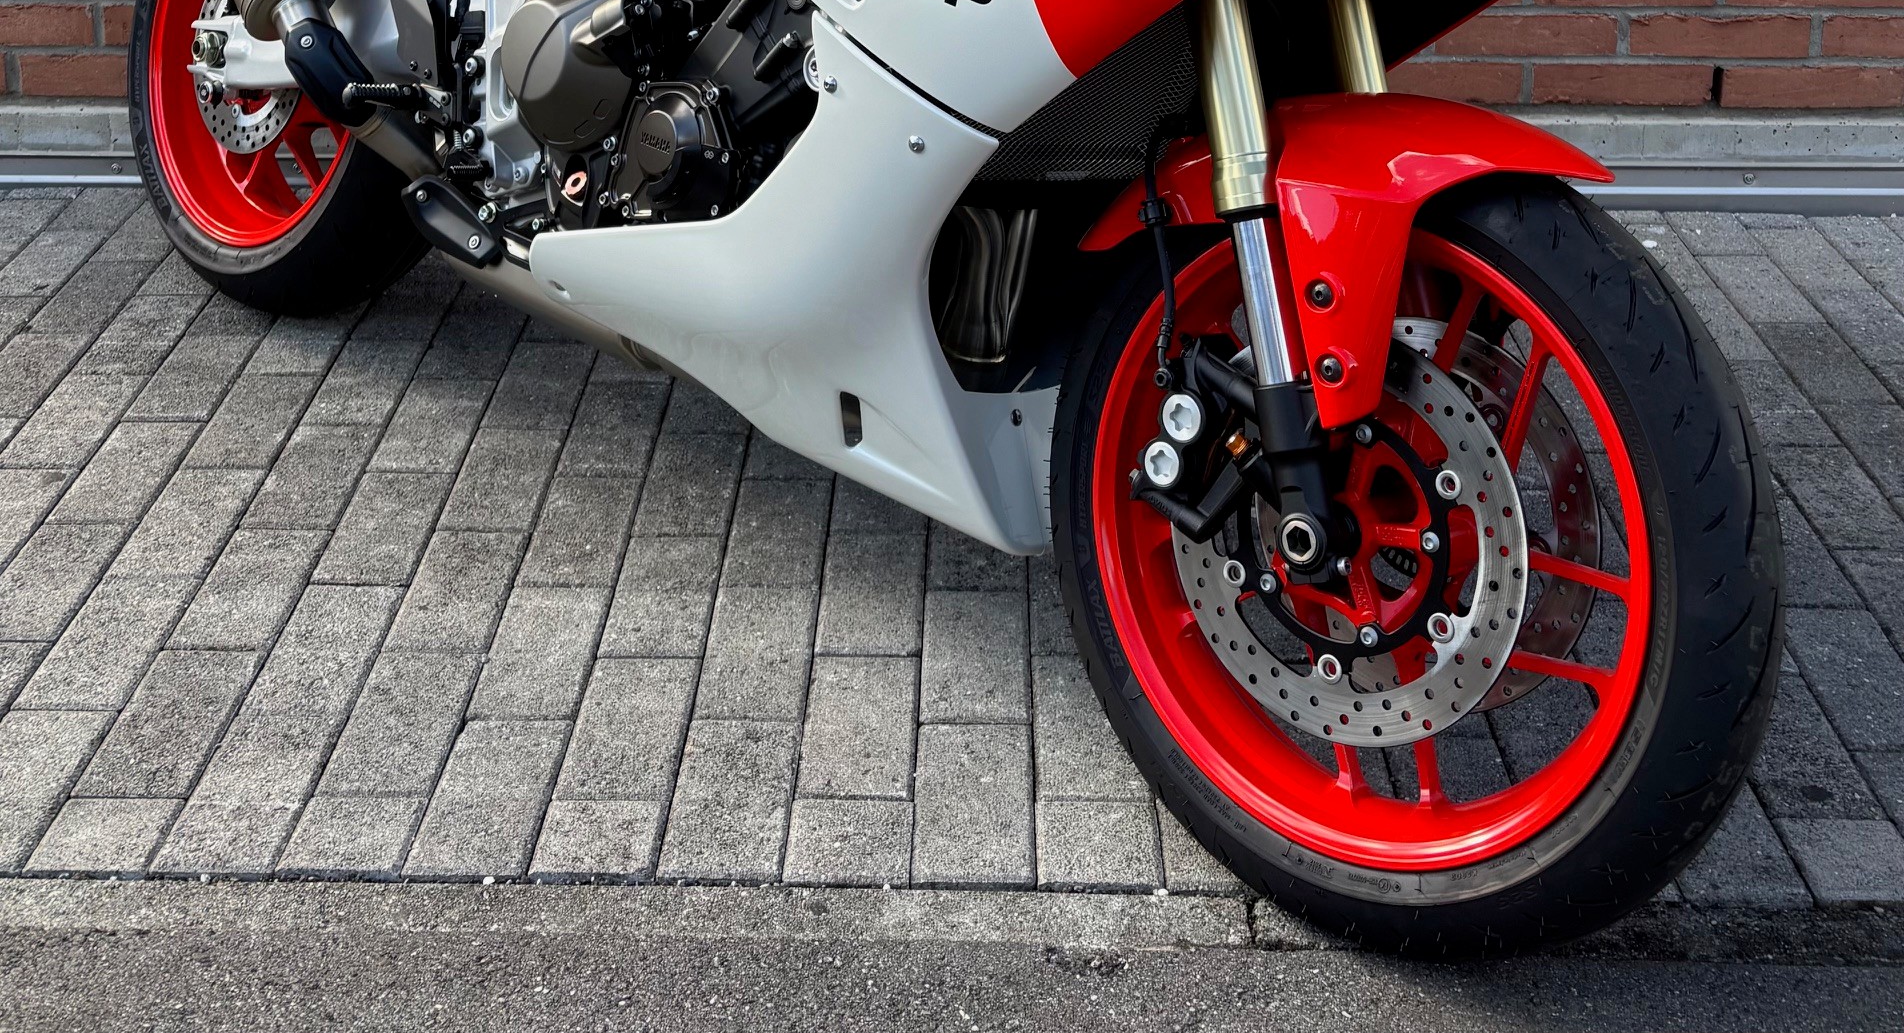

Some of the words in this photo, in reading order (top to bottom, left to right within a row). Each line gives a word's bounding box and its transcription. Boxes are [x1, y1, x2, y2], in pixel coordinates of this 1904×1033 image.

[140, 142, 168, 209] BATTLAX
[640, 131, 671, 155] YAMAHA
[1087, 579, 1125, 669] BATTLAX
